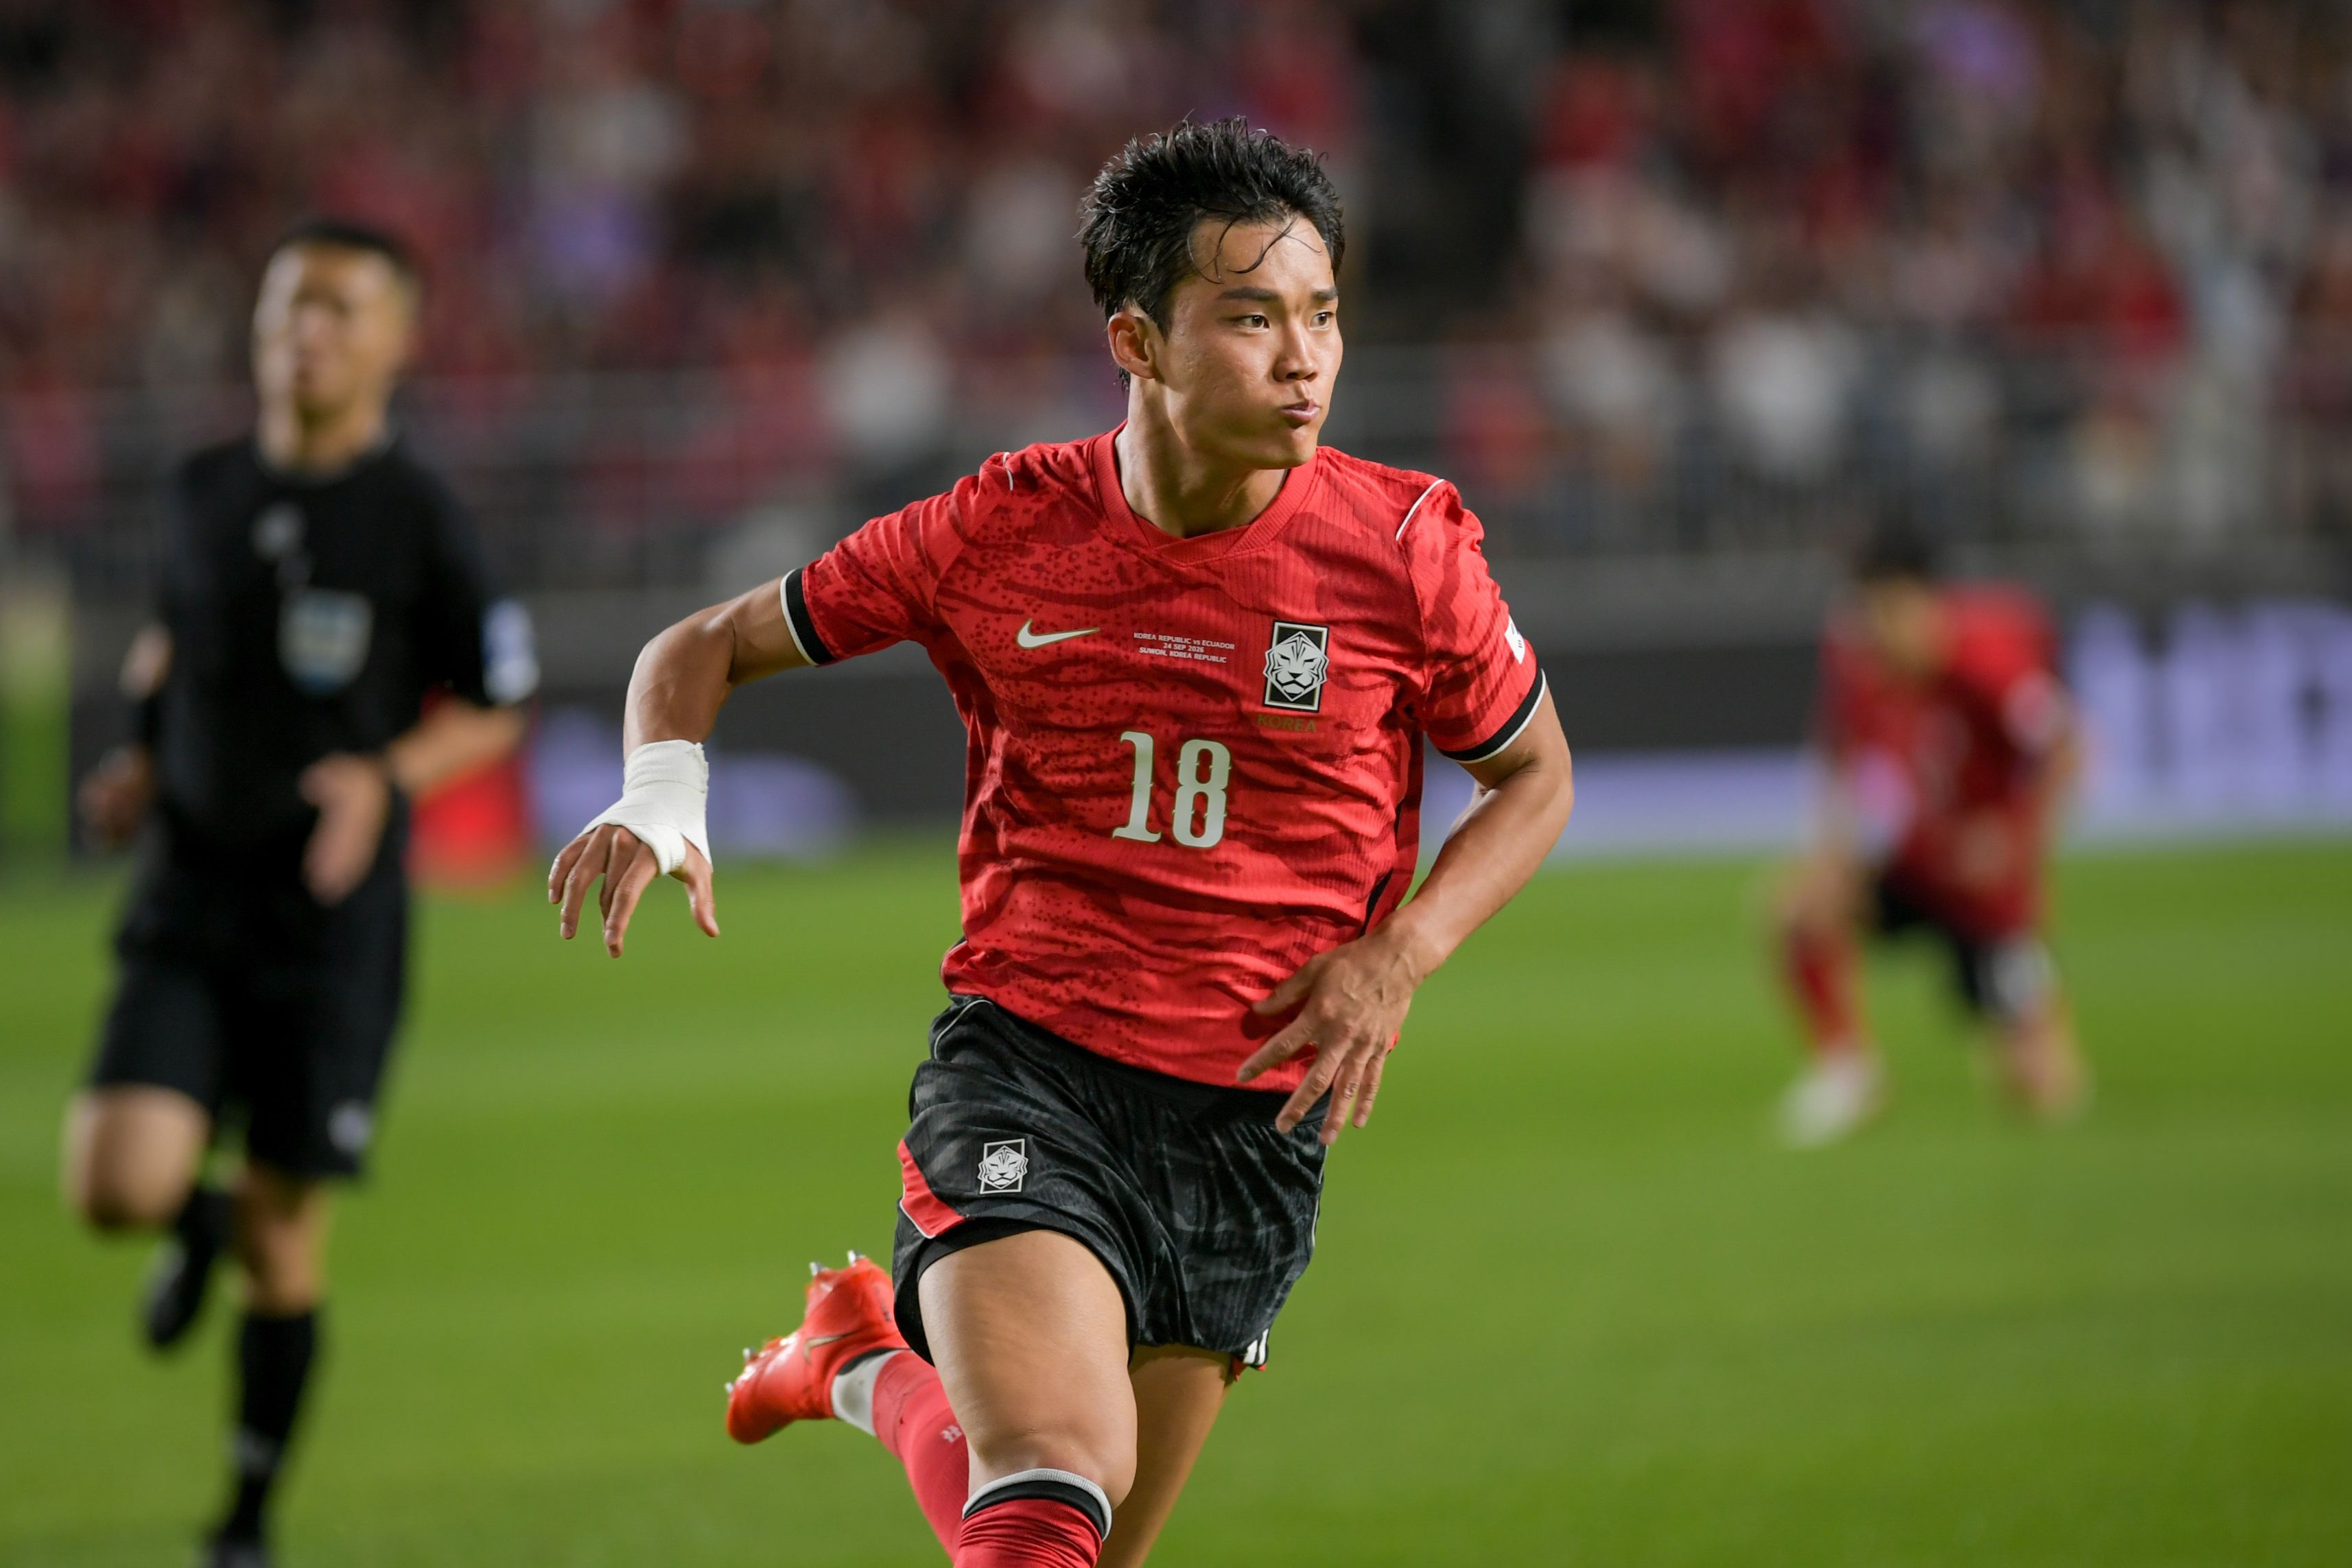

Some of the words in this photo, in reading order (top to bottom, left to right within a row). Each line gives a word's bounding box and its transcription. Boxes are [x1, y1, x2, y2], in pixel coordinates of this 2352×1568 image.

[1158, 634, 1191, 644] REPUBLIC
[1202, 639, 1235, 650] ECUADOR
[1188, 645, 1205, 653] 2026
[1139, 647, 1168, 656] SUWON,
[1169, 650, 1192, 658] KOREA
[1194, 653, 1227, 663] REPUBLIC
[1257, 713, 1317, 733] KOREA
[1112, 730, 1232, 848] 18
